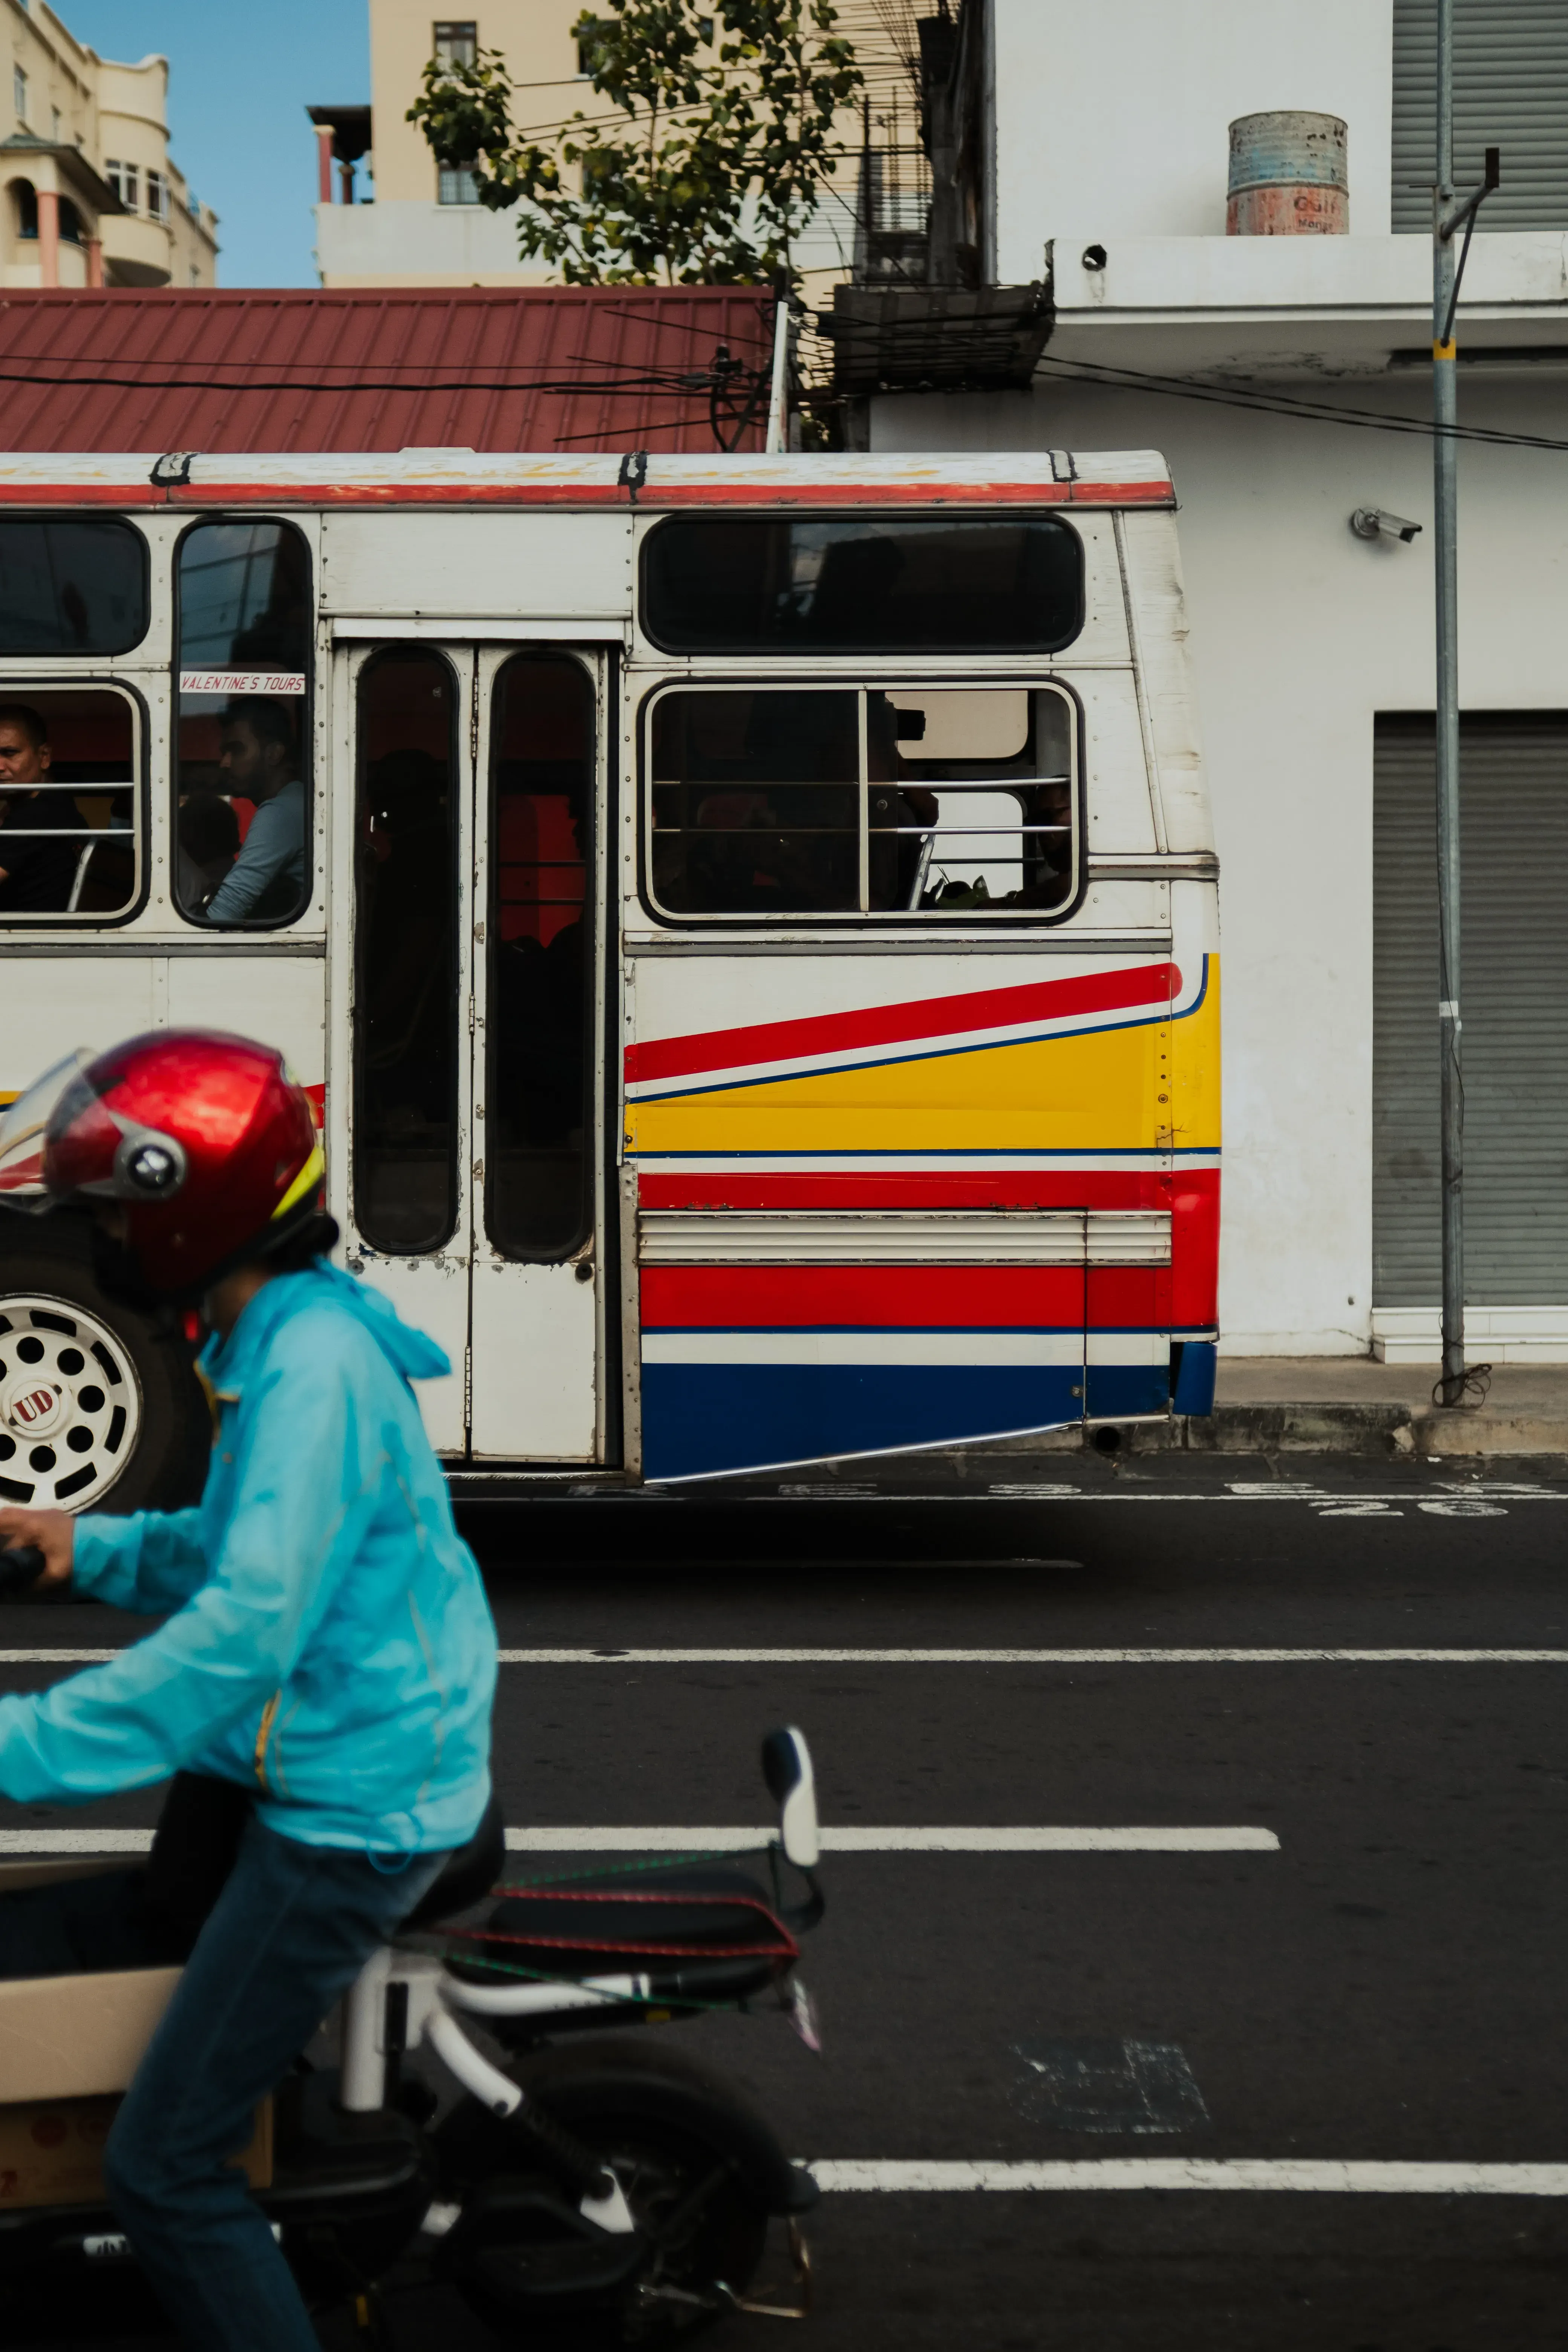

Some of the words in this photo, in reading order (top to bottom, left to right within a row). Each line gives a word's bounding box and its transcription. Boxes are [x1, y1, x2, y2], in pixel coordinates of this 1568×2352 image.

[182, 675, 260, 690] VALENTINE'S
[263, 677, 305, 691] TOURS
[13, 1390, 53, 1422] UD
[1308, 1501, 1508, 1516] 26
